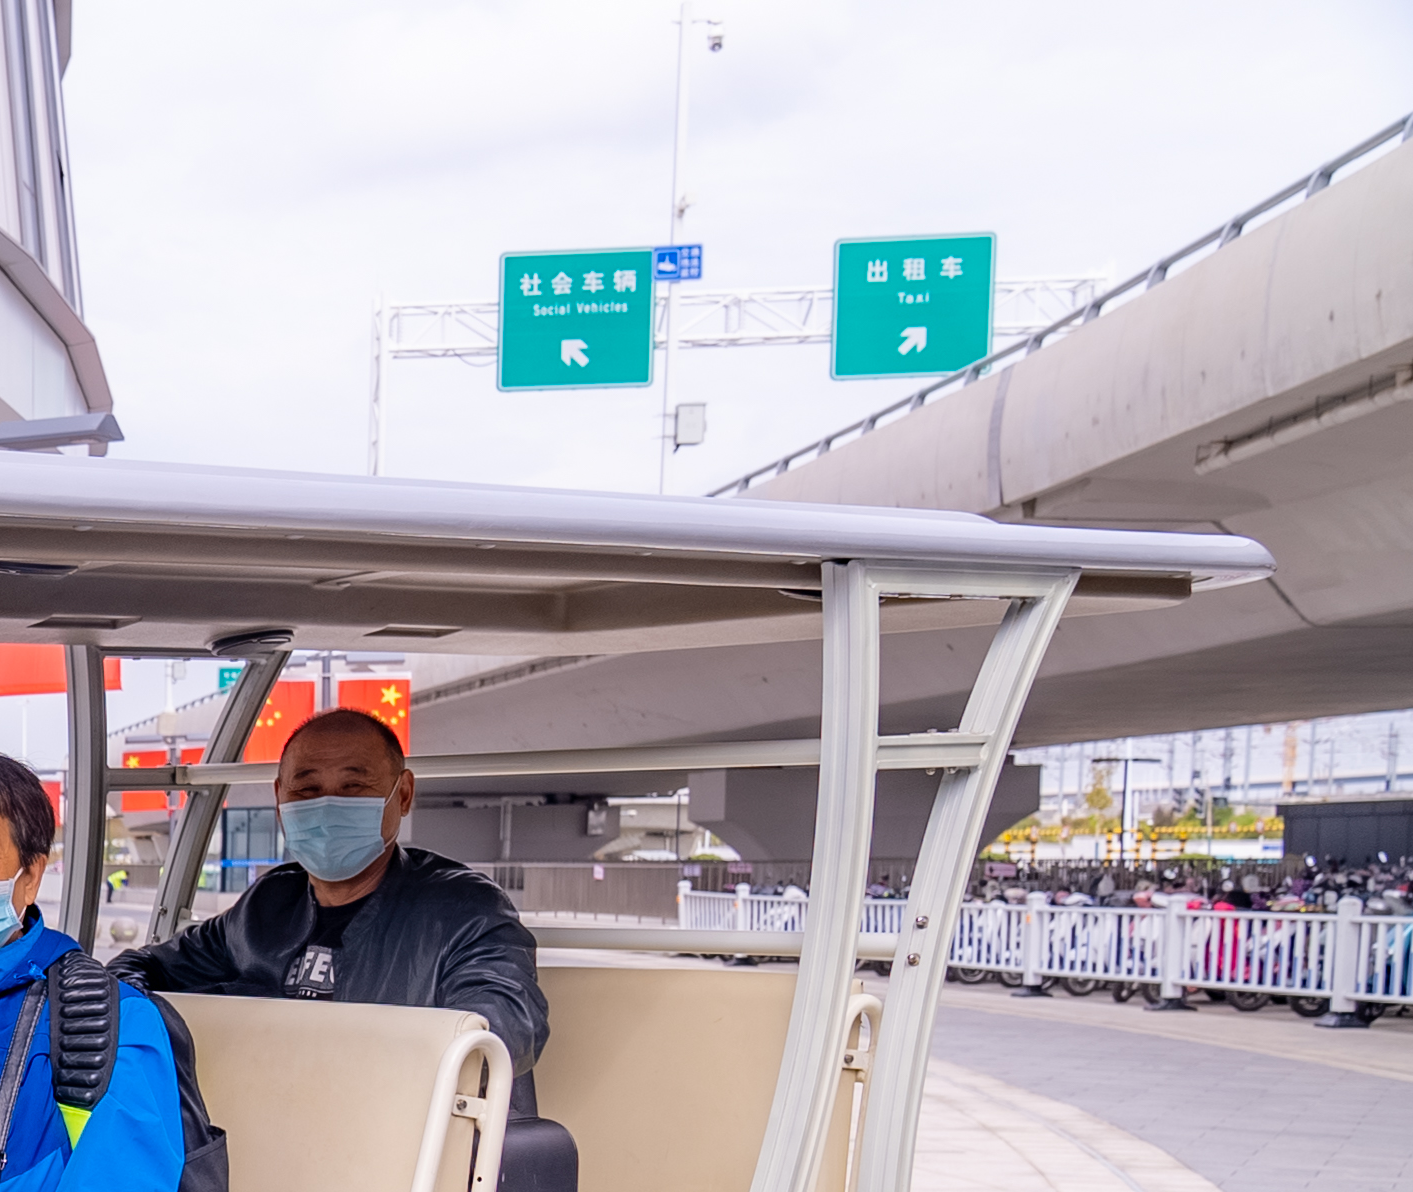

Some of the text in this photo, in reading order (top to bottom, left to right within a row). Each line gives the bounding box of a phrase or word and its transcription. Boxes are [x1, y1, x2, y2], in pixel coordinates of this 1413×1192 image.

[865, 256, 965, 284] 出租车
[519, 269, 638, 297] 社会车辆
[533, 300, 629, 317] Social Vehicles
[897, 291, 932, 305] Taxi
